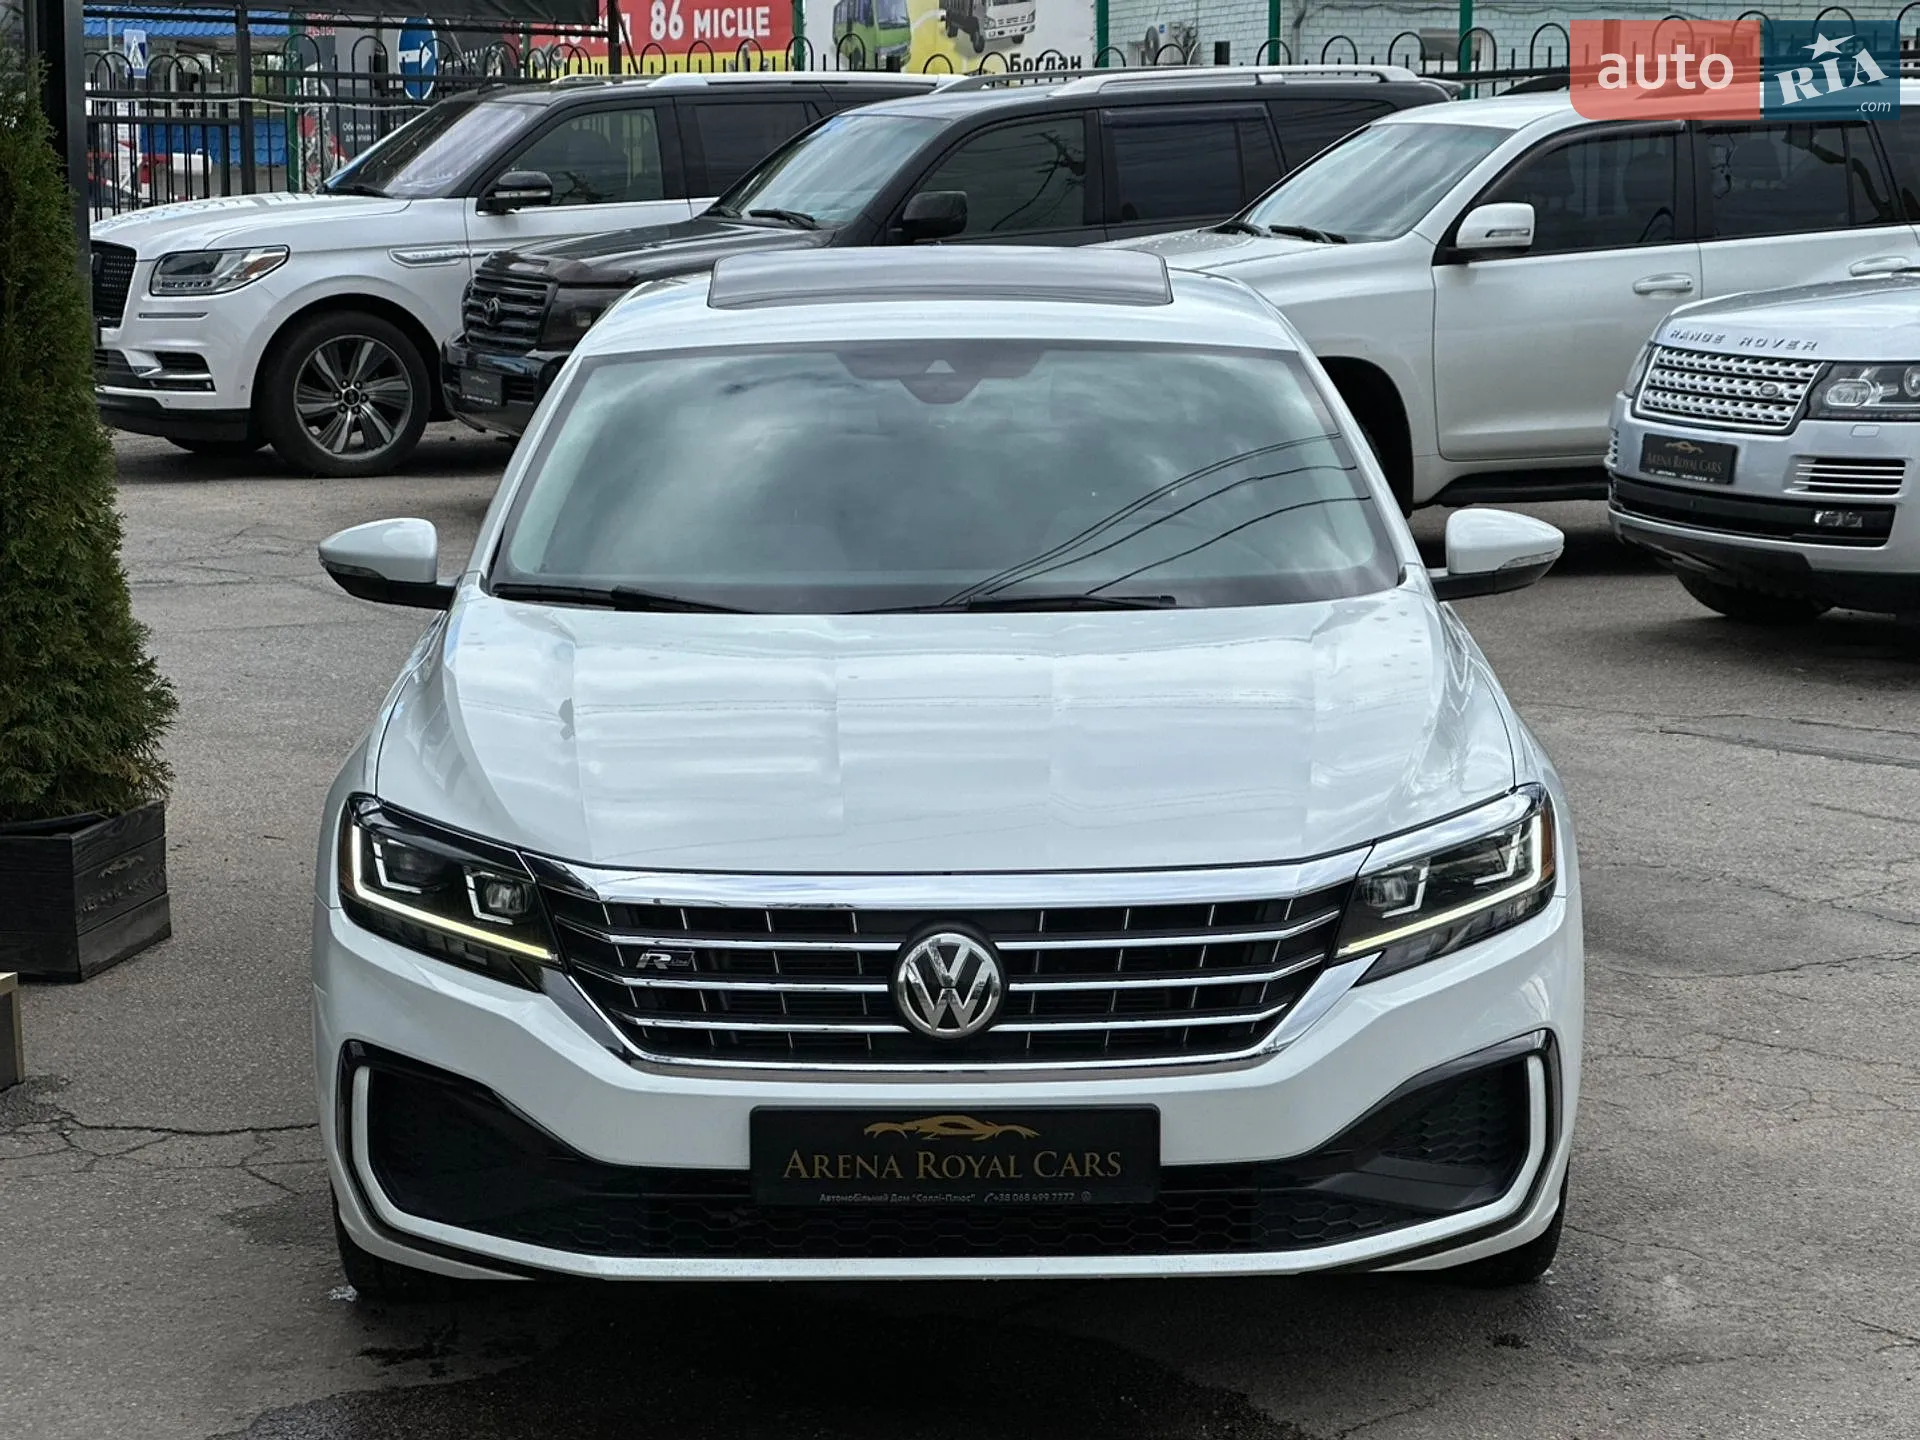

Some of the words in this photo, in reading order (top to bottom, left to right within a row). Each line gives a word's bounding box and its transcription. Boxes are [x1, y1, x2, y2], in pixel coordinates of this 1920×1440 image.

[651, 0, 684, 40] 86
[694, 6, 770, 39] МІСЦЕ
[1010, 52, 1082, 73] Богдан
[1670, 329, 1726, 345] RANGE
[1739, 336, 1818, 352] ROVER
[782, 1149, 904, 1179] ARENA
[916, 1151, 1023, 1179] ROYAL
[1033, 1151, 1121, 1178] CARS
